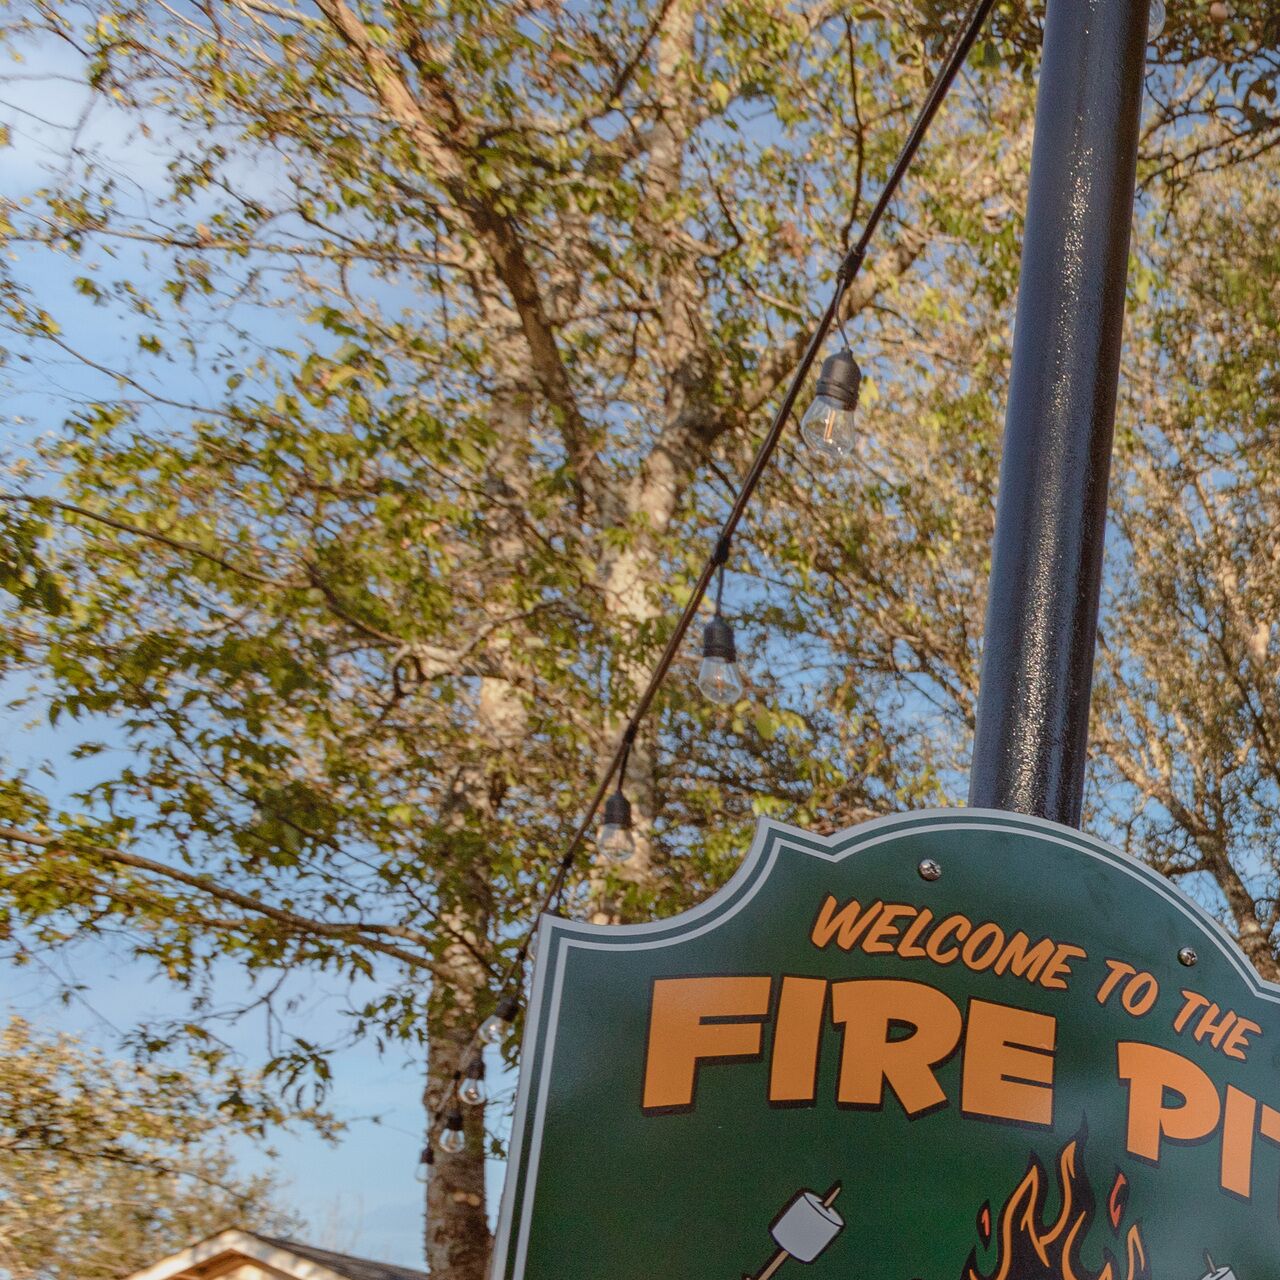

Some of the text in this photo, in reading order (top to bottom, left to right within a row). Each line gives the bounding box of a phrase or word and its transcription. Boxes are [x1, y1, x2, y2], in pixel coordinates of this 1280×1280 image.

[642, 975, 1057, 1126] FIRE
[810, 894, 1261, 1061] WELCOME TO THE
